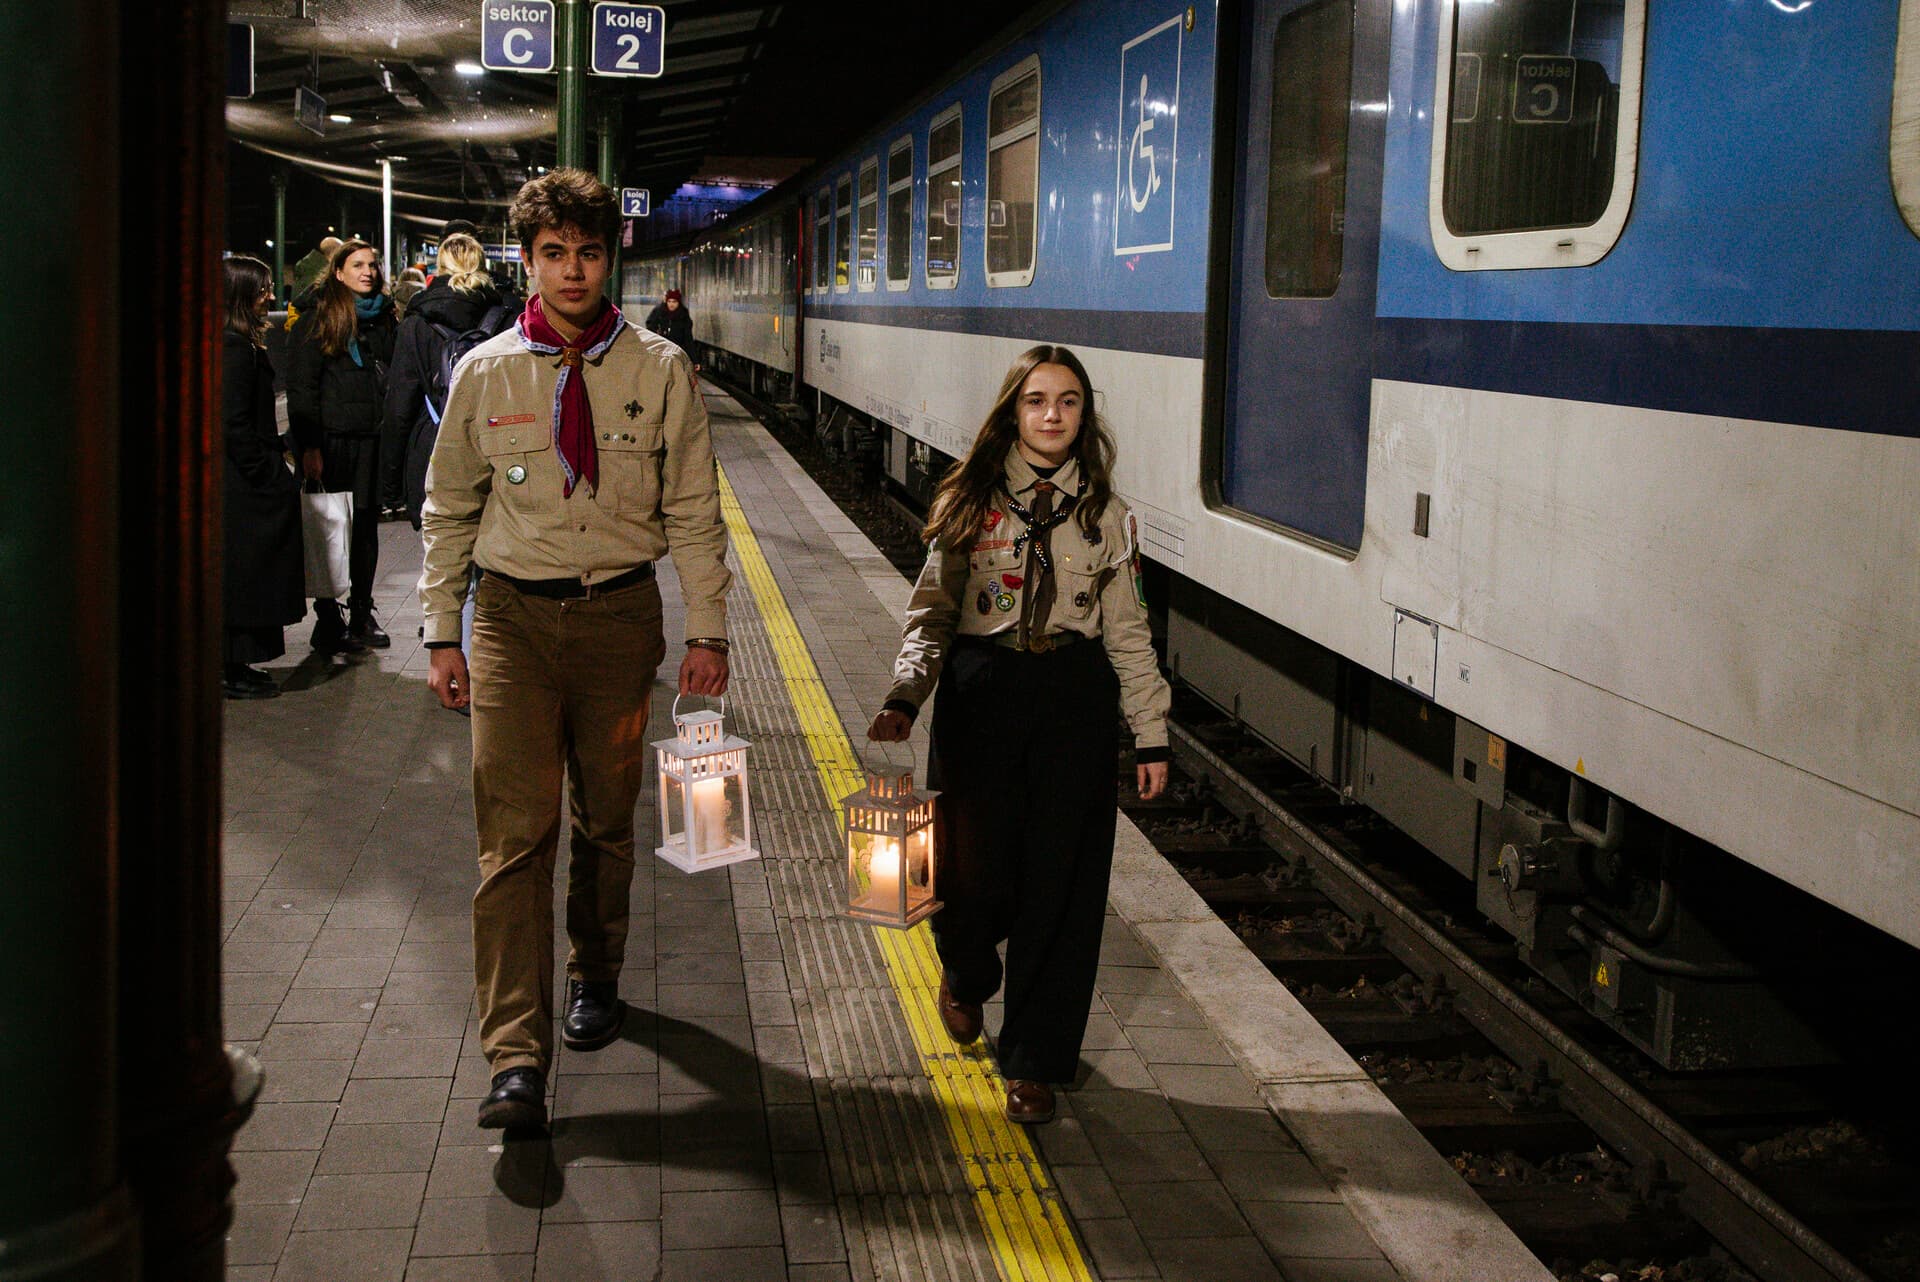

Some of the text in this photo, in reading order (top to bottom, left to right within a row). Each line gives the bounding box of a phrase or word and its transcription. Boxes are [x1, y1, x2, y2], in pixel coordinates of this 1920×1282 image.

[489, 5, 548, 23] sektor
[606, 10, 653, 33] kolej
[503, 27, 534, 64] C
[615, 34, 640, 70] 2
[627, 191, 645, 200] kolej
[630, 200, 640, 214] 2
